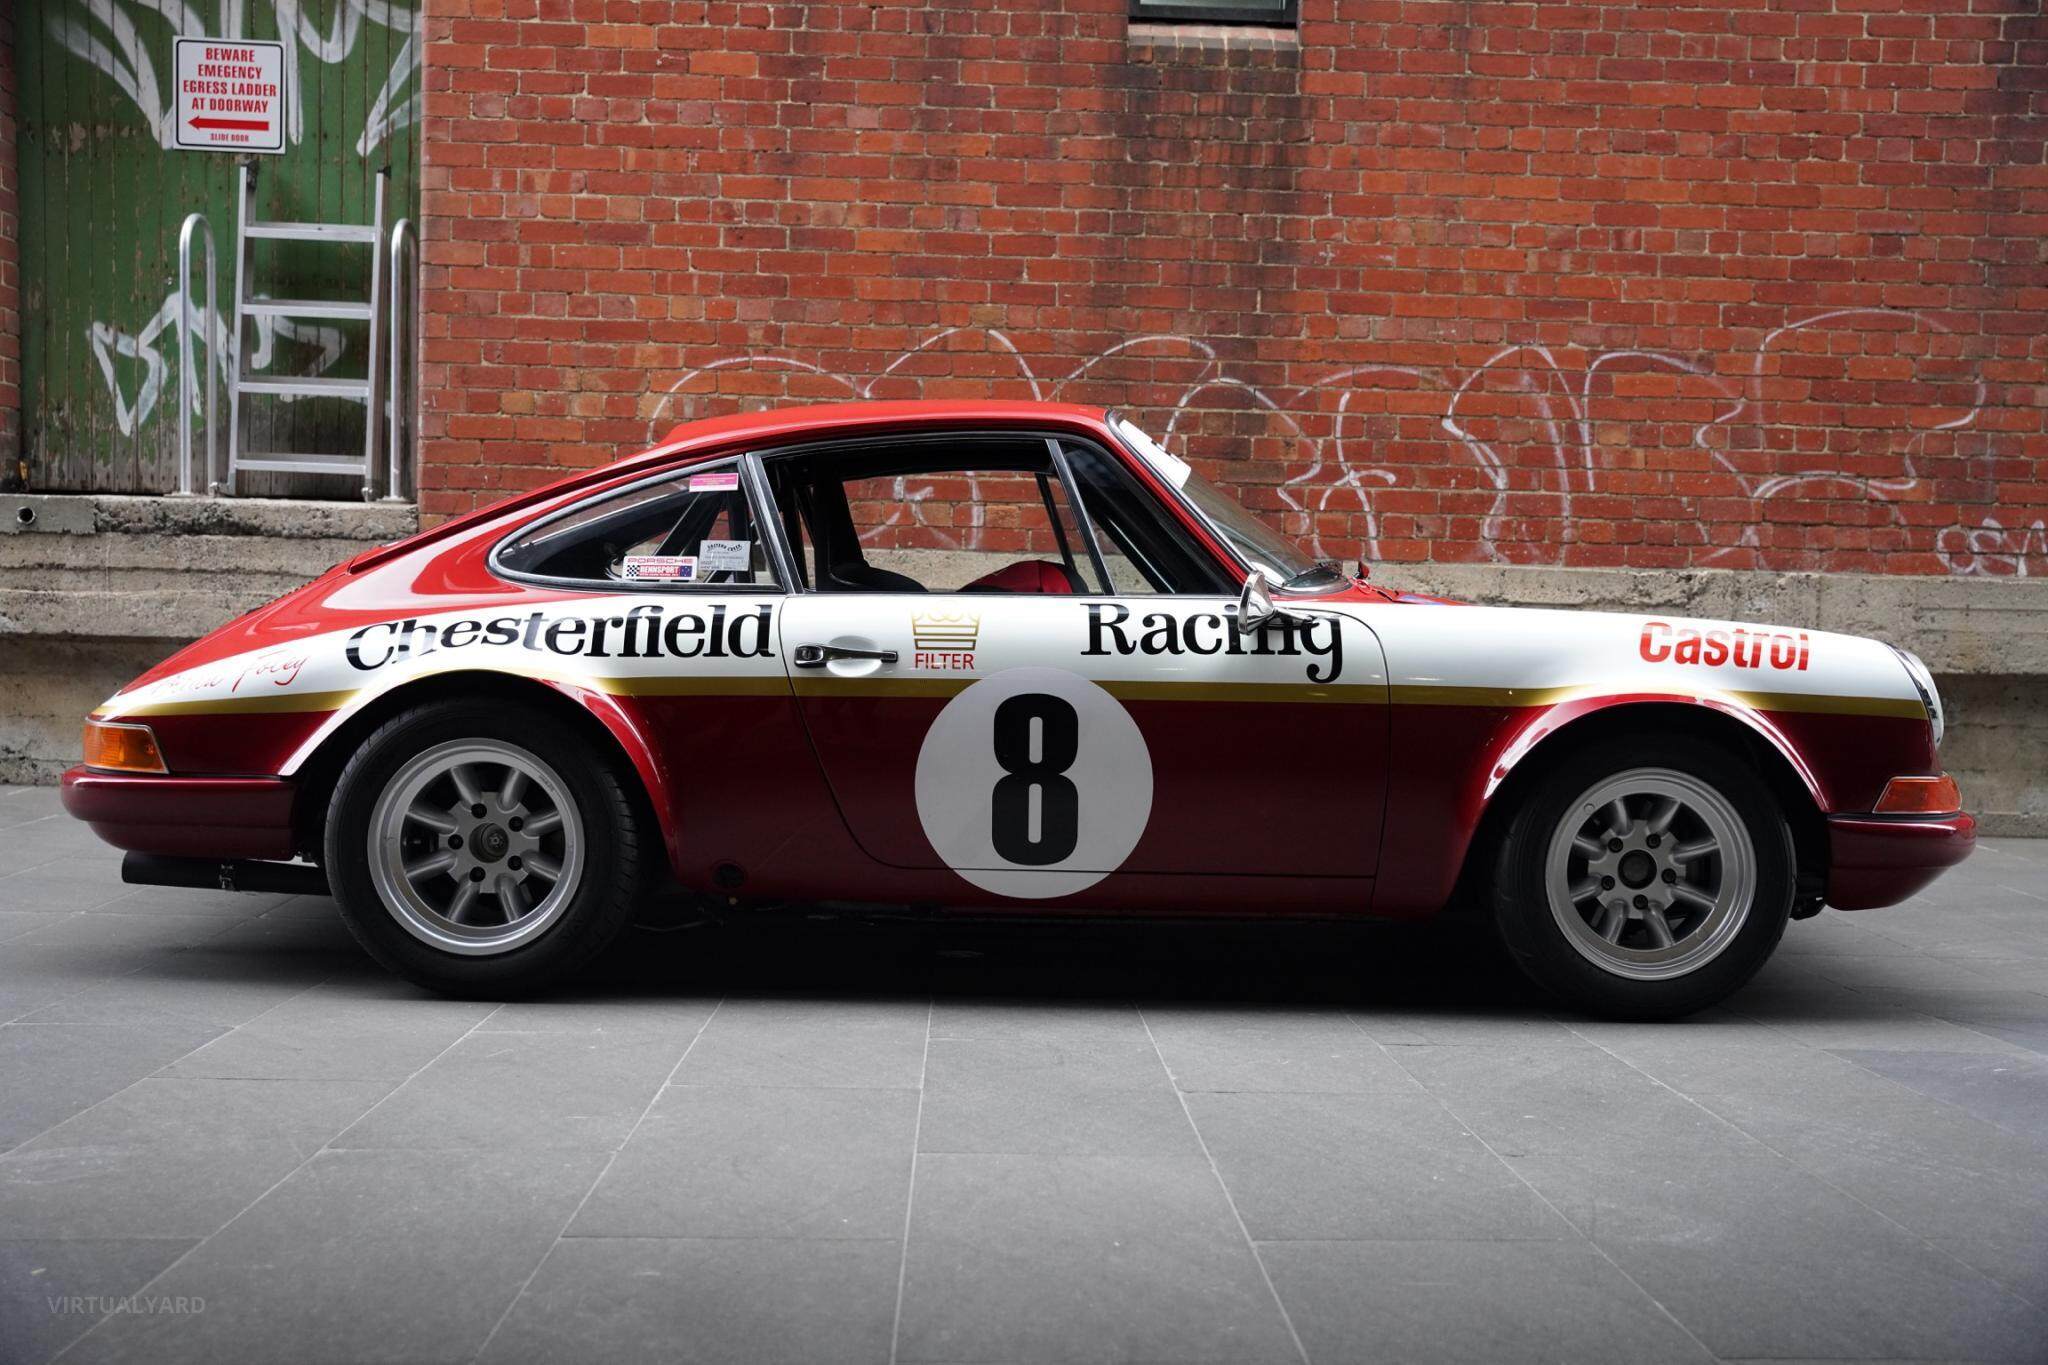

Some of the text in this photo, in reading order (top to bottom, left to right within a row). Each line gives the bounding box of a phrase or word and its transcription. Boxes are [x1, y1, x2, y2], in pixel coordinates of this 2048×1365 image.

[205, 47, 255, 62] BEWARE
[197, 64, 262, 79] EMEGENCY
[183, 80, 276, 97] EGRESS LADDER
[191, 97, 269, 113] AT DOORWAY
[345, 603, 1344, 684] Chesterfield Racing
[1639, 622, 1809, 671] Castrol
[914, 653, 975, 670] FILTER
[991, 693, 1079, 866] 8
